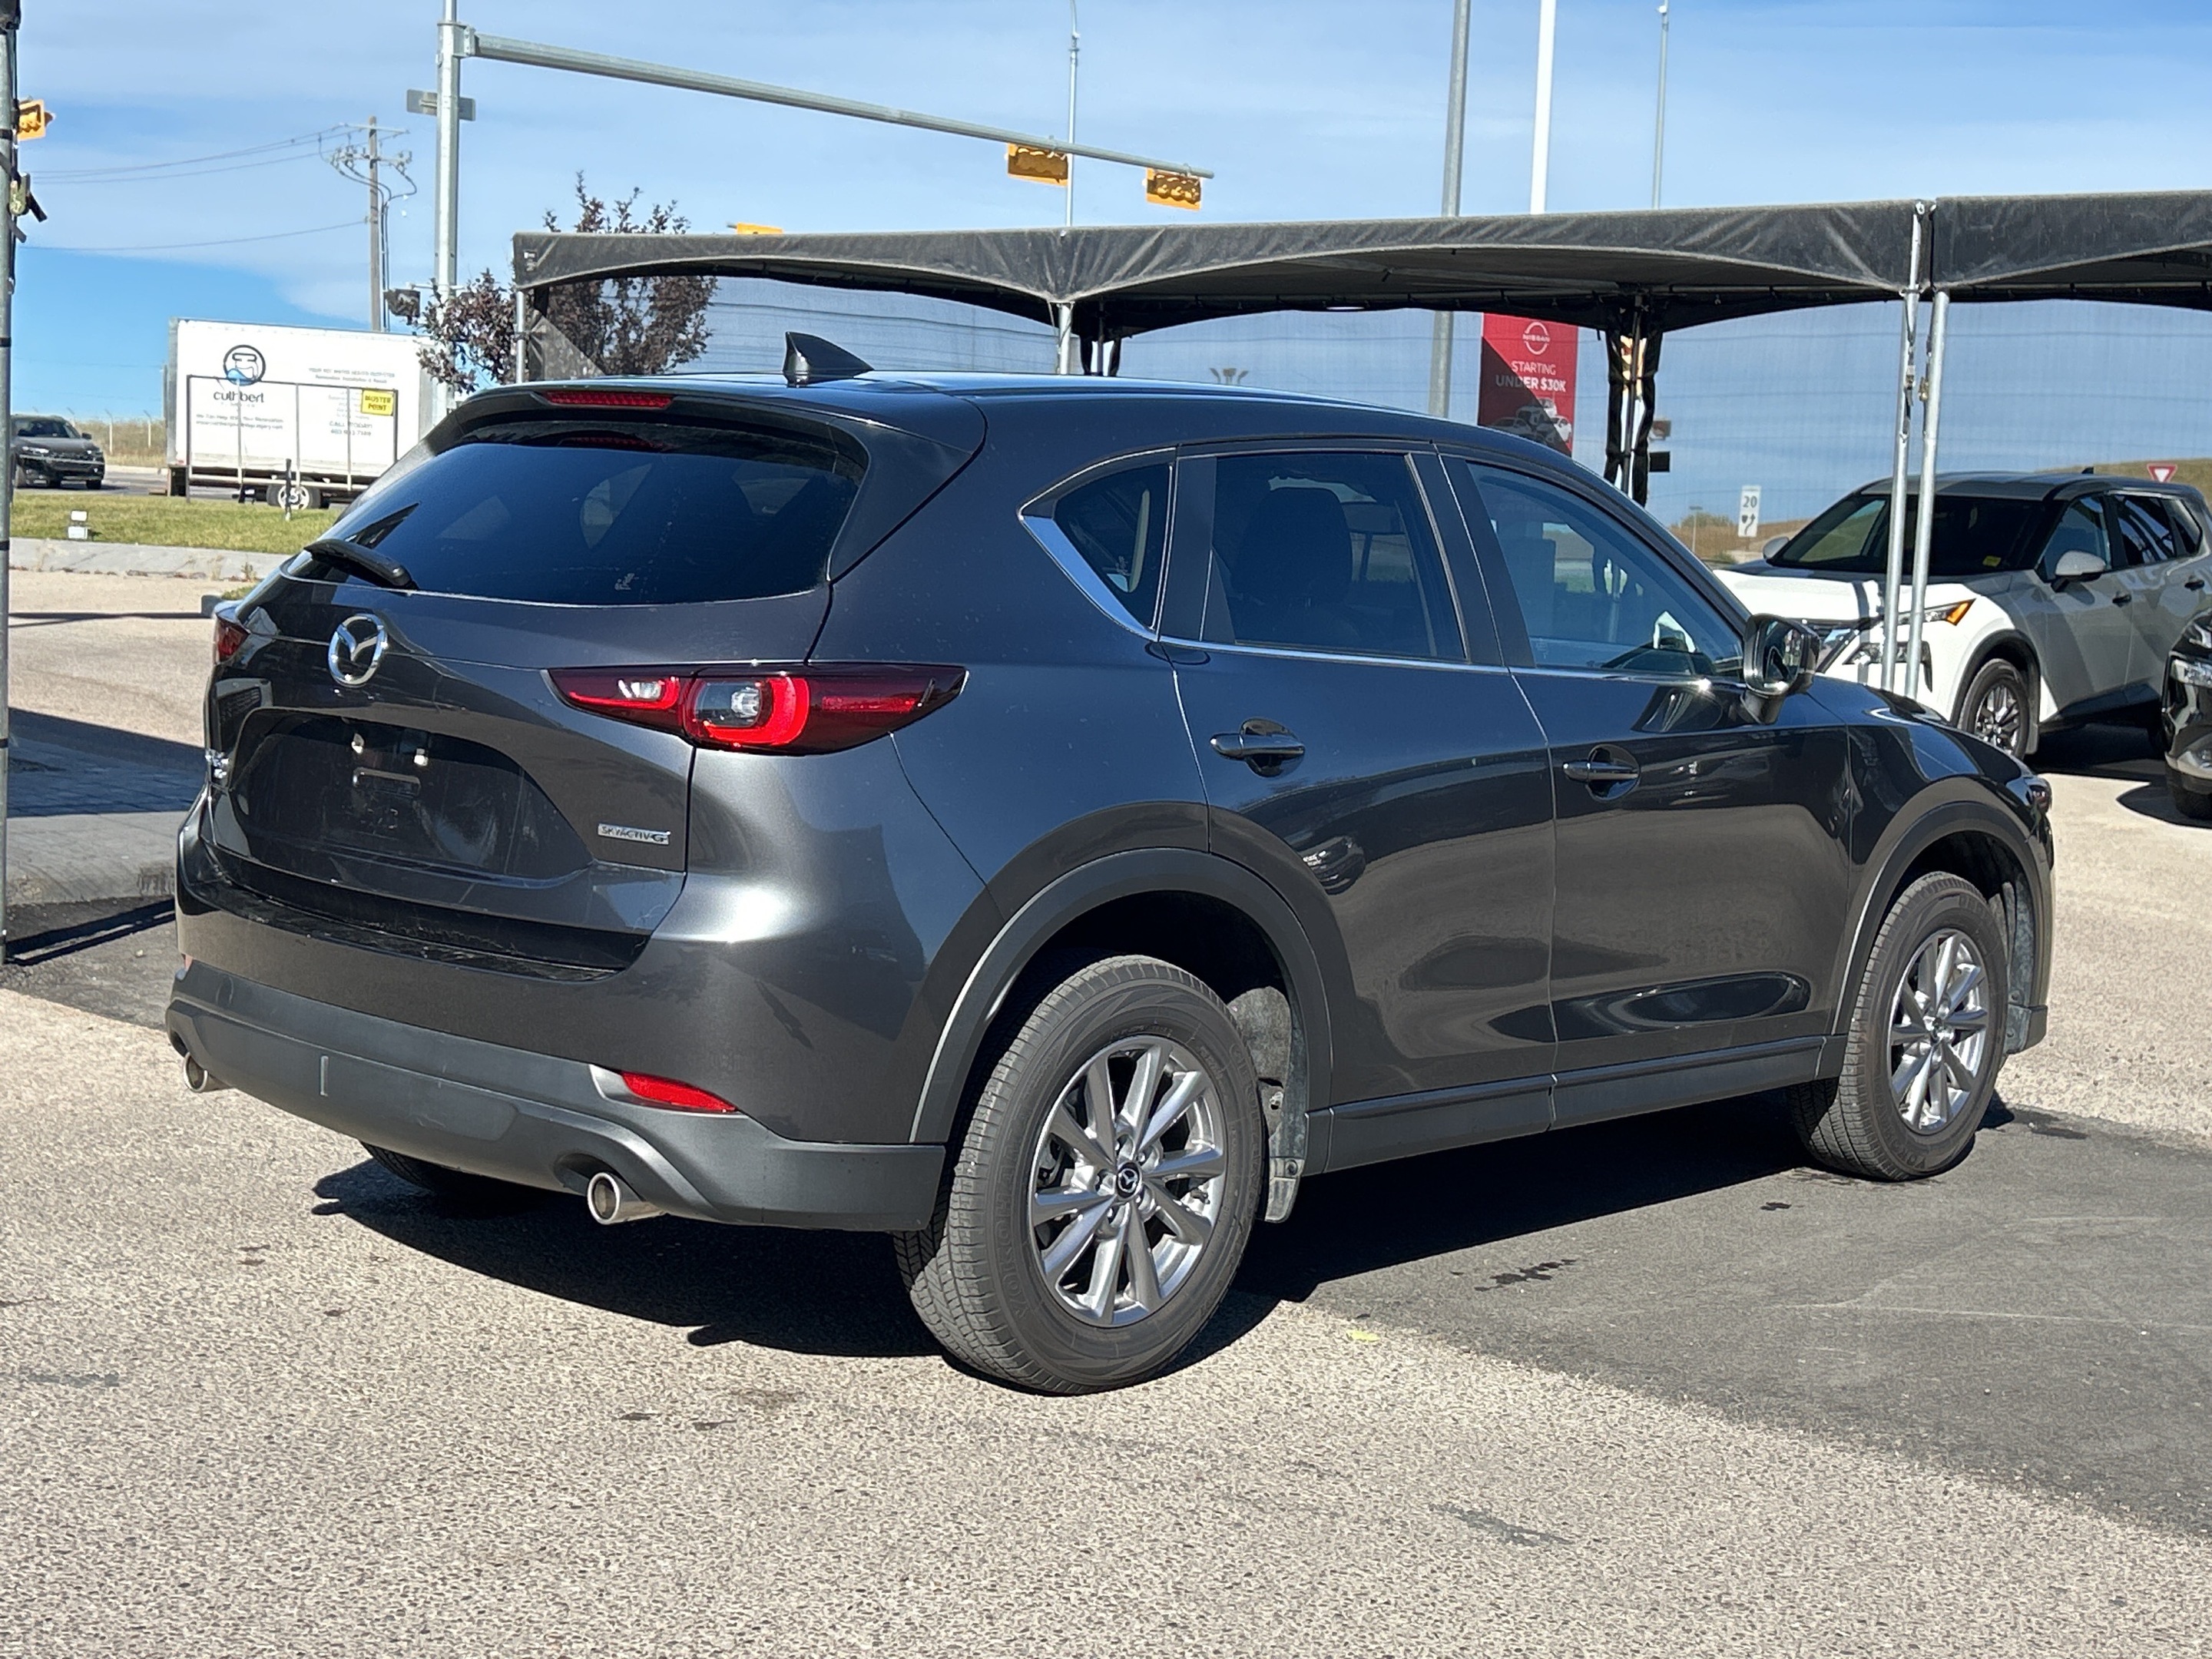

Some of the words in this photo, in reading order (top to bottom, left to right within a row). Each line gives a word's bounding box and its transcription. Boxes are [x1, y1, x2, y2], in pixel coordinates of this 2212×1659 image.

[1511, 360, 1556, 376] STARTING
[1495, 375, 1538, 389] UNDER
[1540, 377, 1566, 392] $30K
[365, 395, 392, 404] MUSTER
[368, 402, 387, 411] POINT
[1743, 495, 1757, 508] 20
